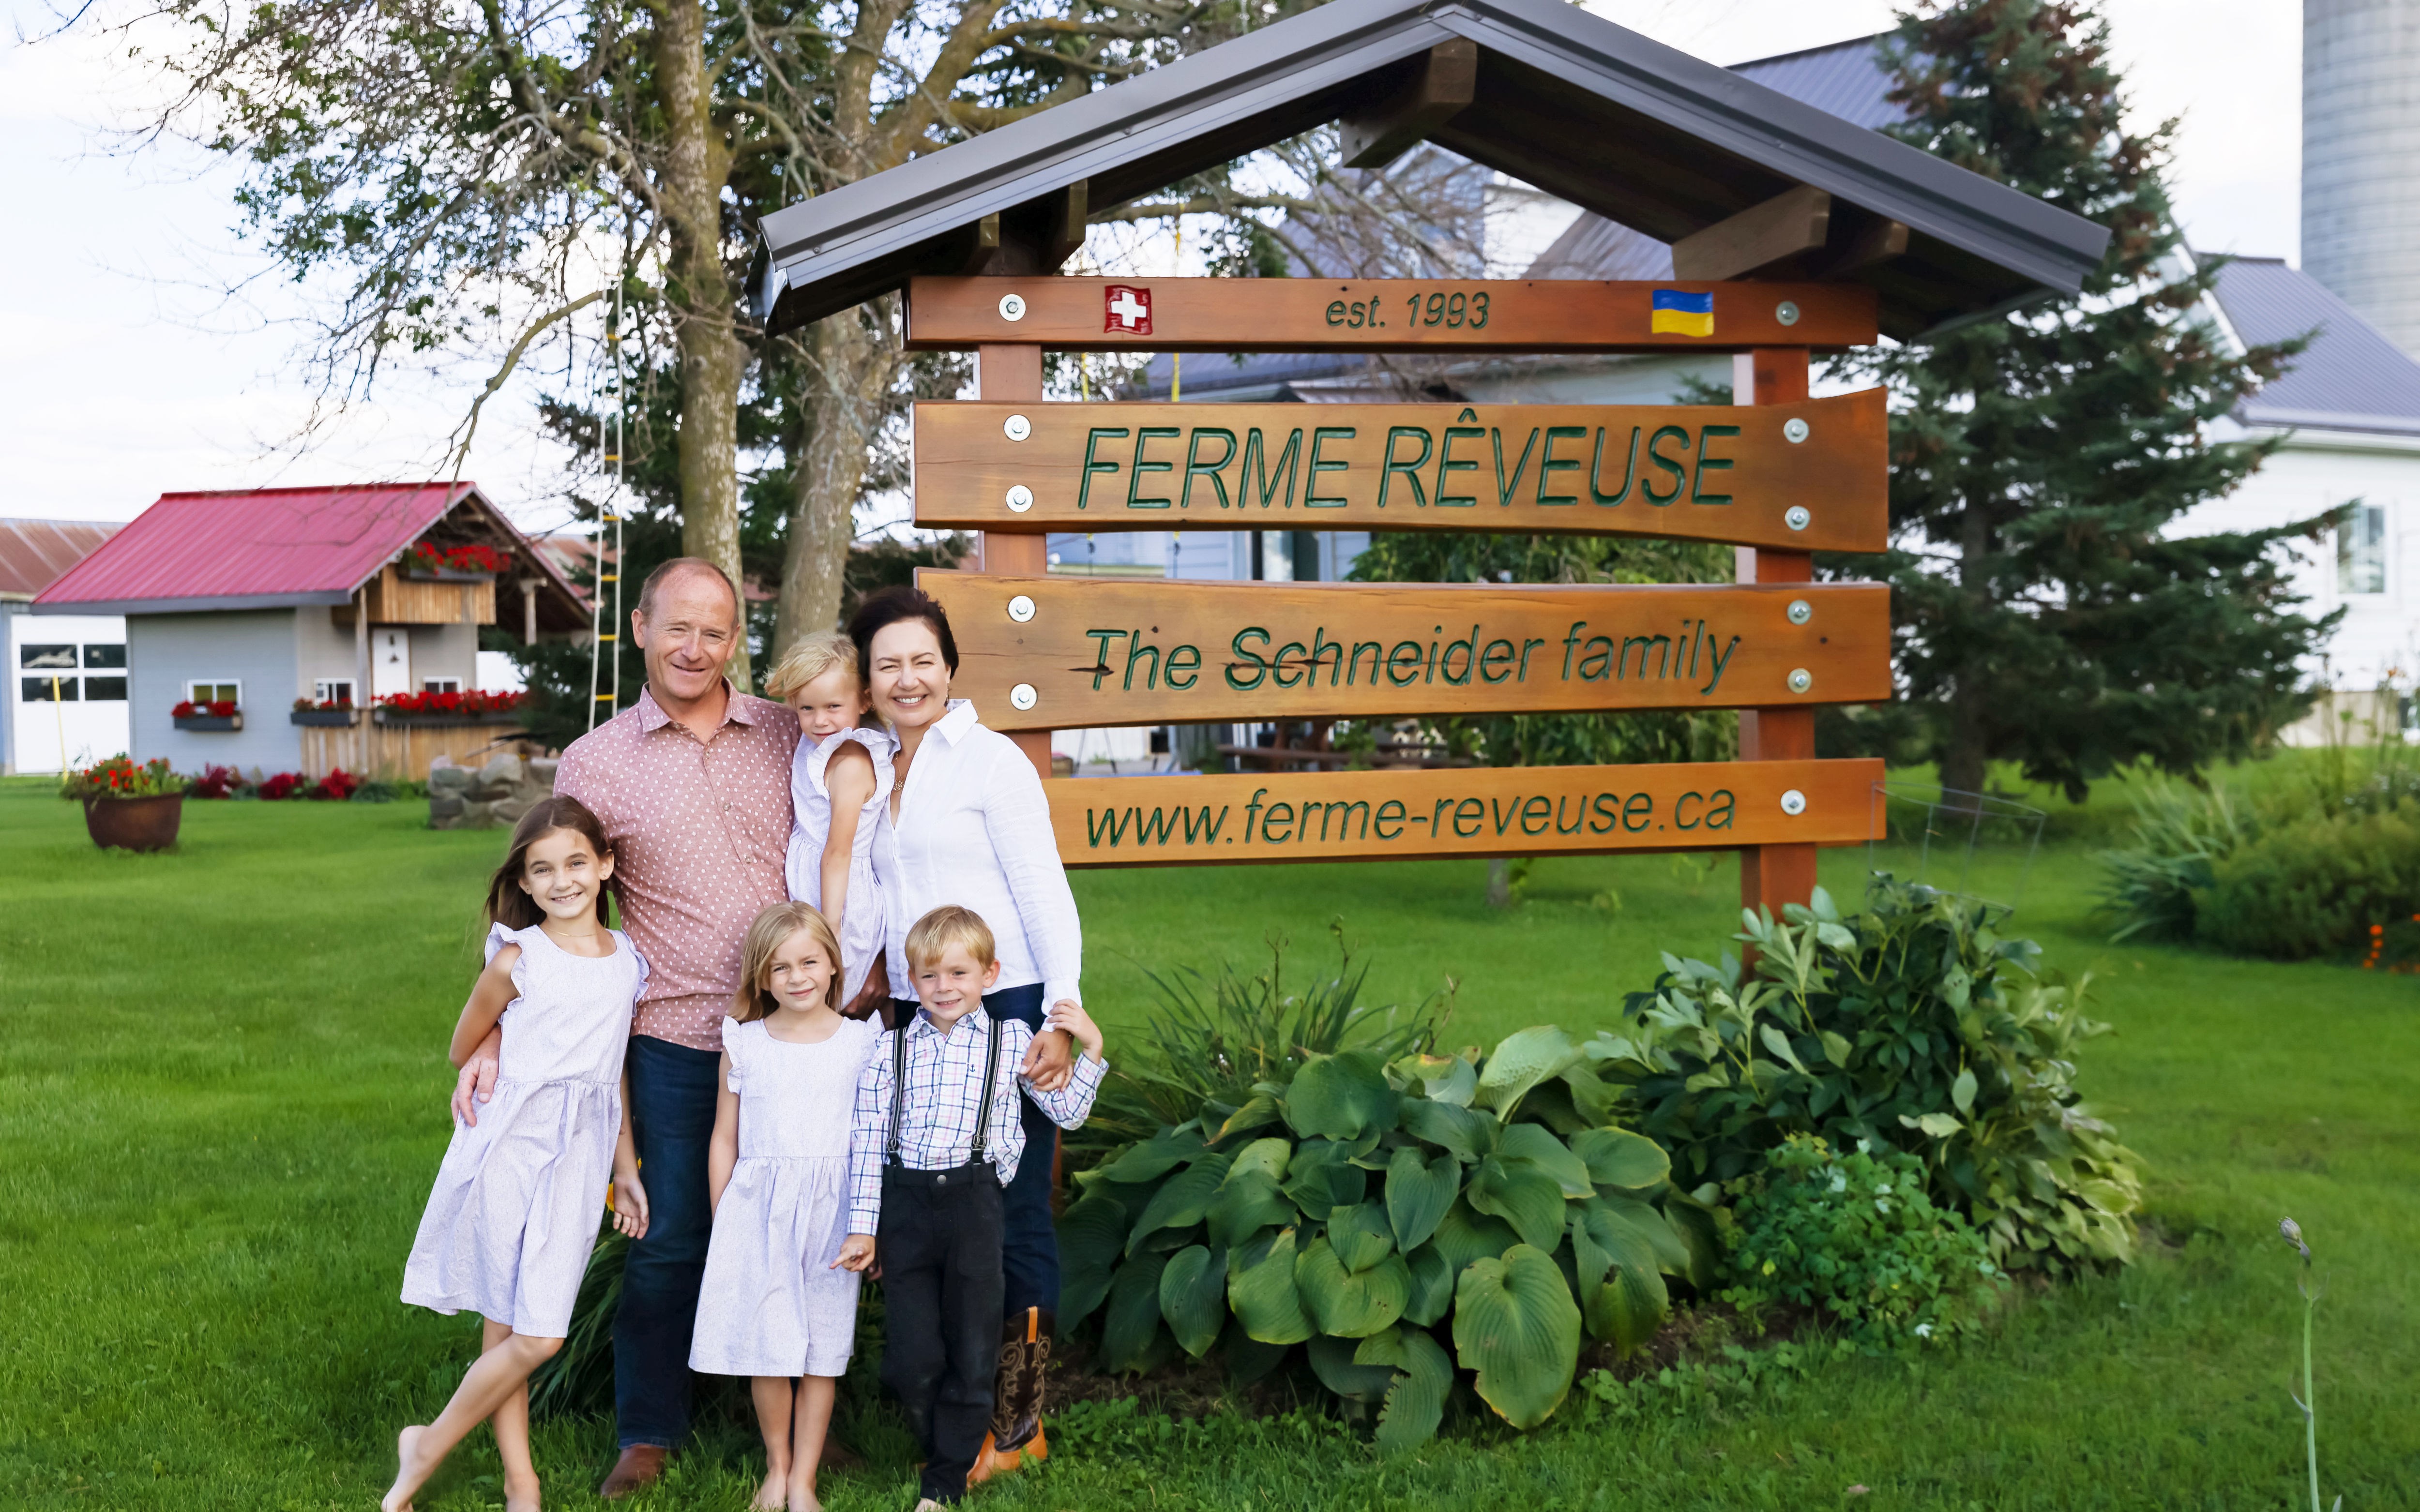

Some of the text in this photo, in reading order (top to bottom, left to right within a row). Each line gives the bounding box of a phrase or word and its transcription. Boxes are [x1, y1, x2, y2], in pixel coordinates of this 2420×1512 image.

[1325, 291, 1490, 330] est. 1993
[1078, 408, 1740, 509] FERME RÊVEUSE
[1086, 618, 1742, 695] The Schneider family
[1087, 787, 1736, 848] www.ferme-reveuse.ca
